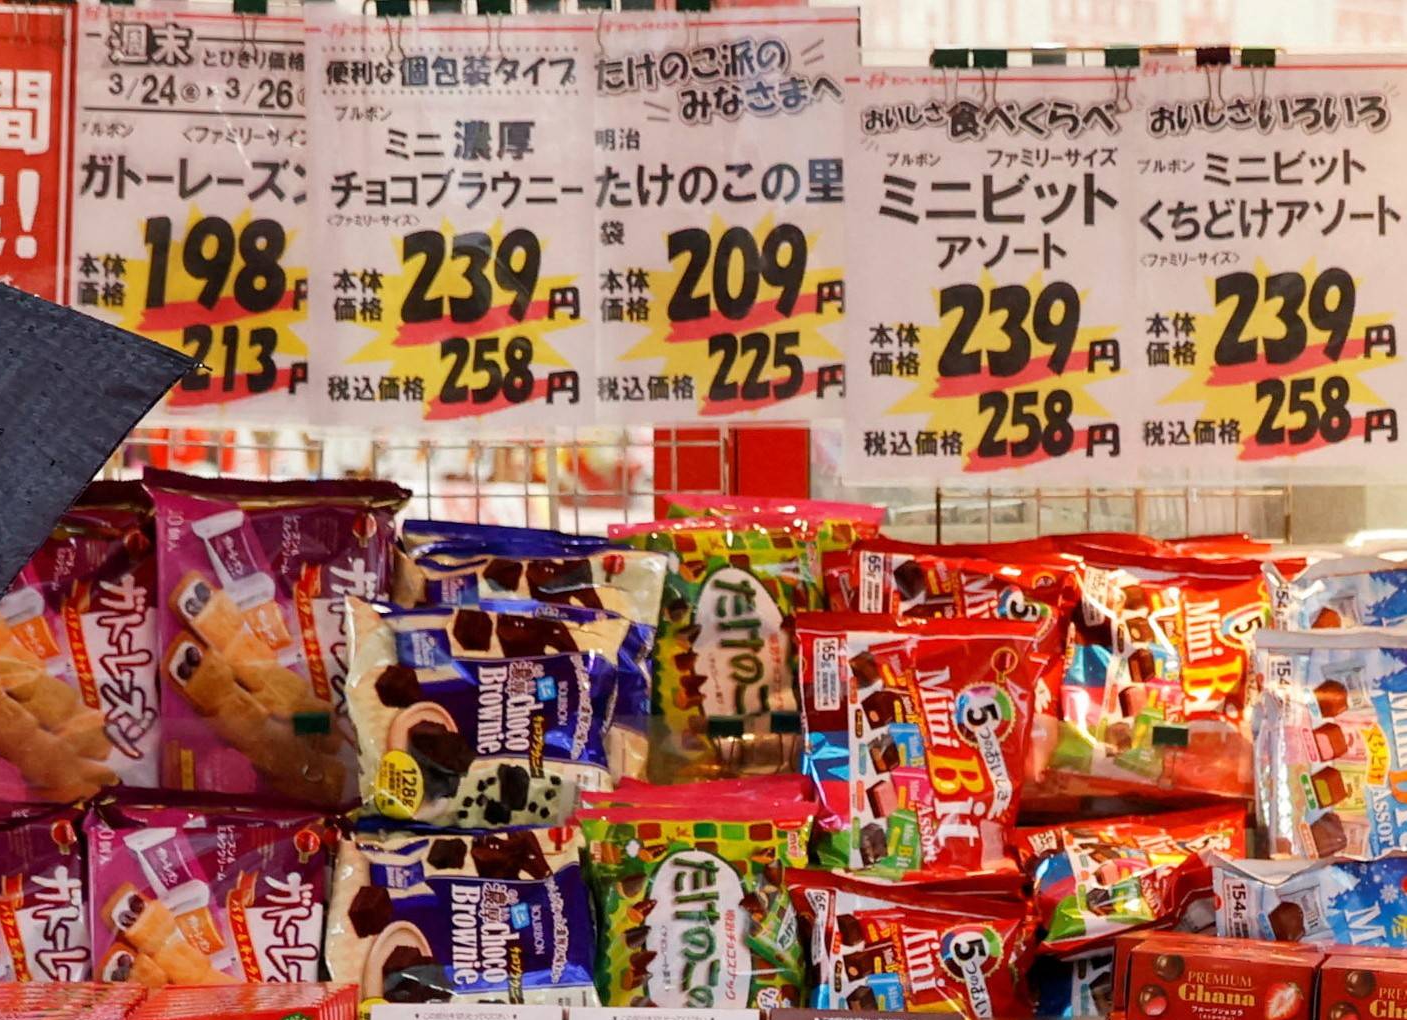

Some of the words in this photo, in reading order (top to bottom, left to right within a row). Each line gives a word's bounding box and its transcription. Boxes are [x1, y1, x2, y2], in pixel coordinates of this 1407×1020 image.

[106, 22, 194, 67] 週末
[326, 56, 577, 87] 便利な個包装タイプ
[595, 40, 787, 91] たけのこ派の
[680, 77, 842, 121] みなさまへ
[864, 100, 1116, 138] おいしさ食べくらべ
[1150, 96, 1388, 134] おいしさいろいろ
[595, 128, 641, 150] 明治
[986, 148, 1118, 168] ファミリーサイズ
[1204, 149, 1367, 187] ミニビット
[330, 168, 583, 209] チョコブラウニー
[595, 158, 845, 208] たけのこの里
[879, 173, 1119, 226] ミニビット
[1139, 195, 1402, 242] くちどけアソート
[936, 232, 1067, 269] アソート
[333, 269, 383, 294] 本体
[600, 269, 650, 294] 本体
[333, 297, 383, 322] 価格
[600, 298, 650, 322] 価格
[869, 323, 921, 348] 本体
[1145, 312, 1197, 338] 本体
[869, 352, 921, 377] 価格
[1146, 341, 1197, 367] 価格
[327, 376, 425, 402] 税込価格
[597, 376, 694, 402] 税込価格
[864, 431, 963, 457] 税込価格
[1142, 420, 1242, 446] 税込価格
[1187, 970, 1253, 988] PREMIUM
[1177, 983, 1256, 1008] Ghana
